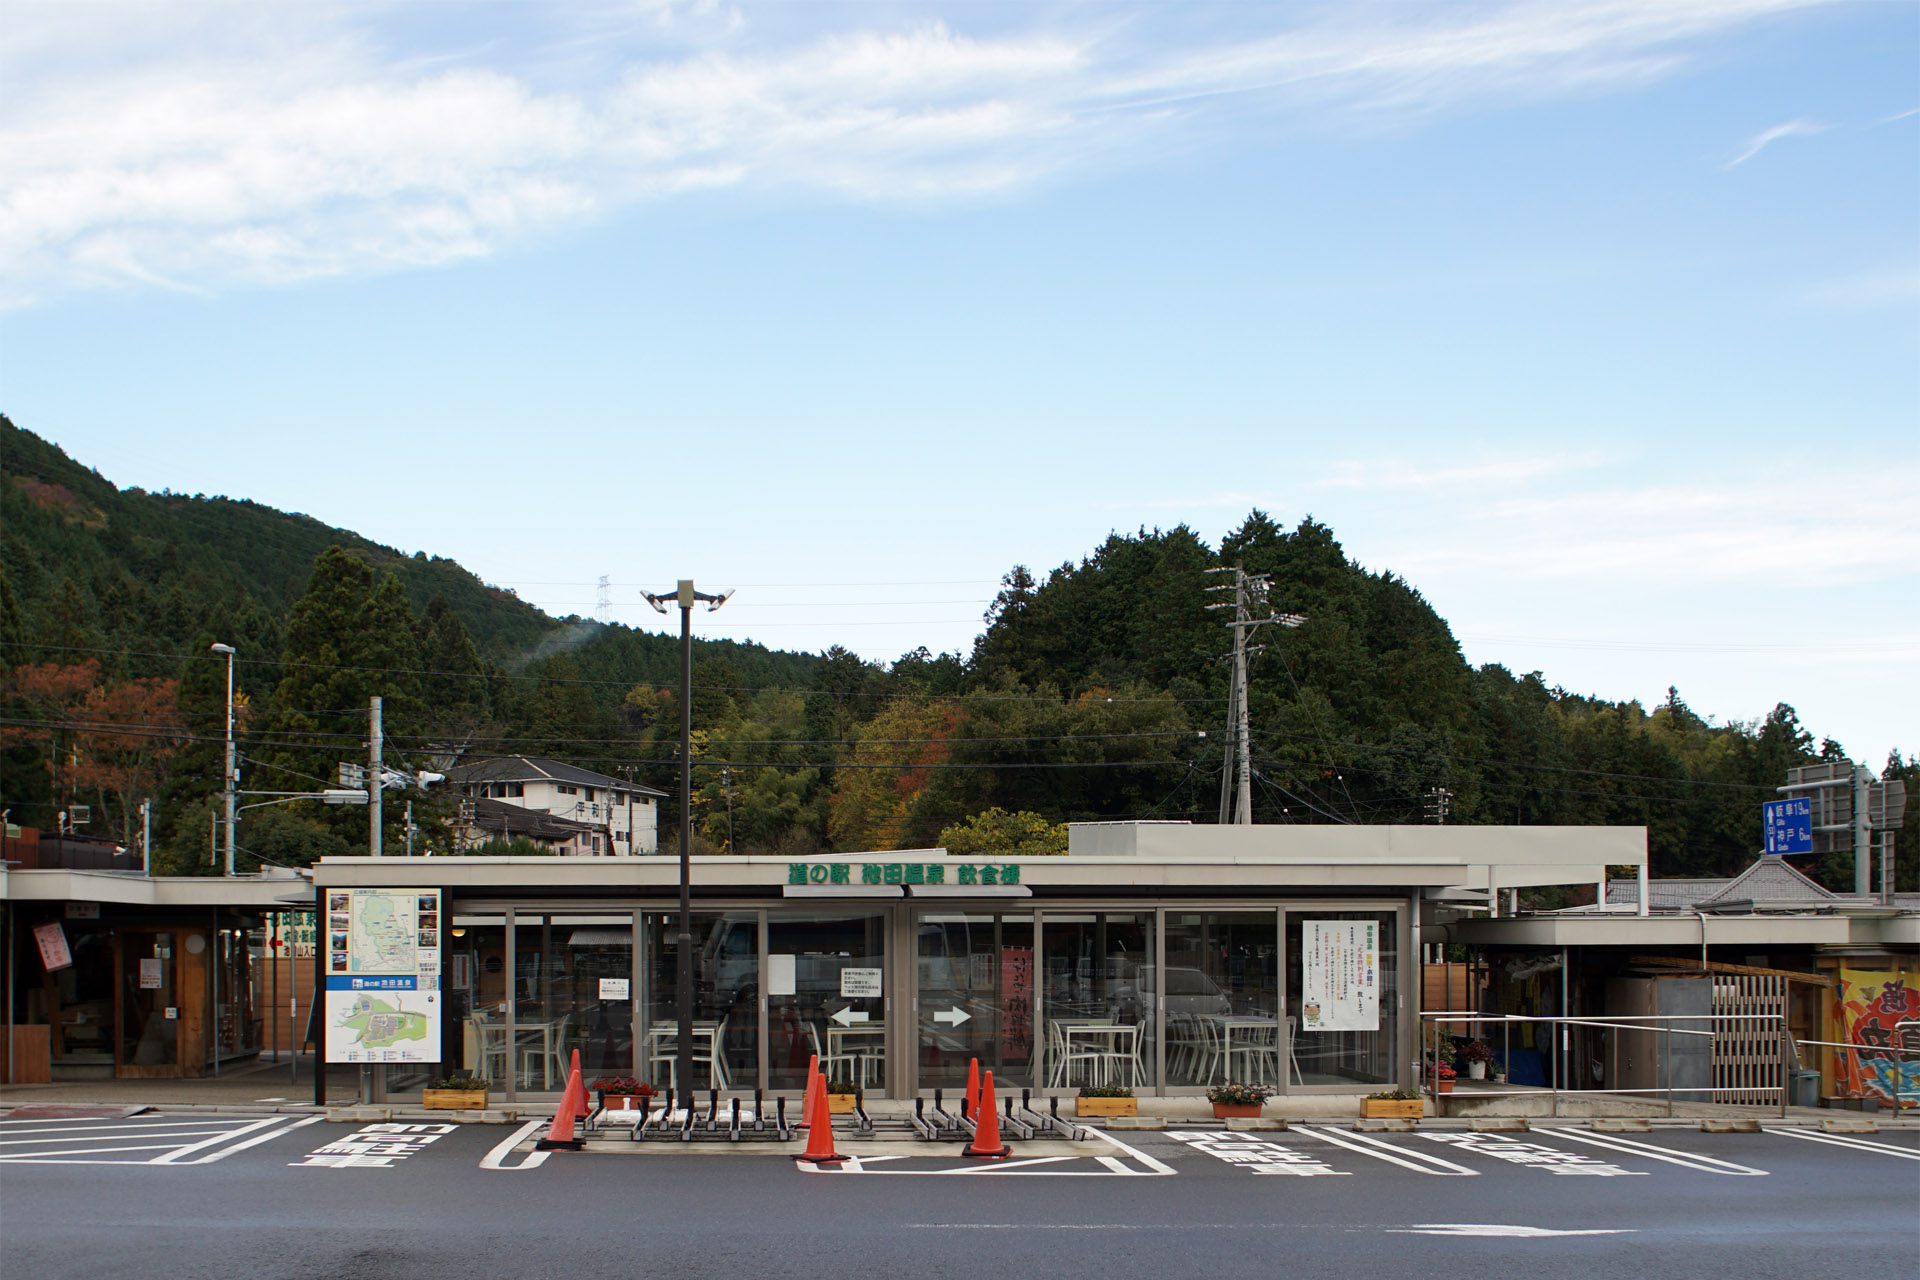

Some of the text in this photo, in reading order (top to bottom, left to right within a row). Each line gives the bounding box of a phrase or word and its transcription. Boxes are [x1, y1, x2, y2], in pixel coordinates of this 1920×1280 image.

[1776, 803, 1793, 817] 岐阜
[1777, 828, 1795, 842] 神戸
[788, 864, 1020, 884] 道の駅 池田温泉 飲食棟
[284, 945, 317, 957] 池山入口
